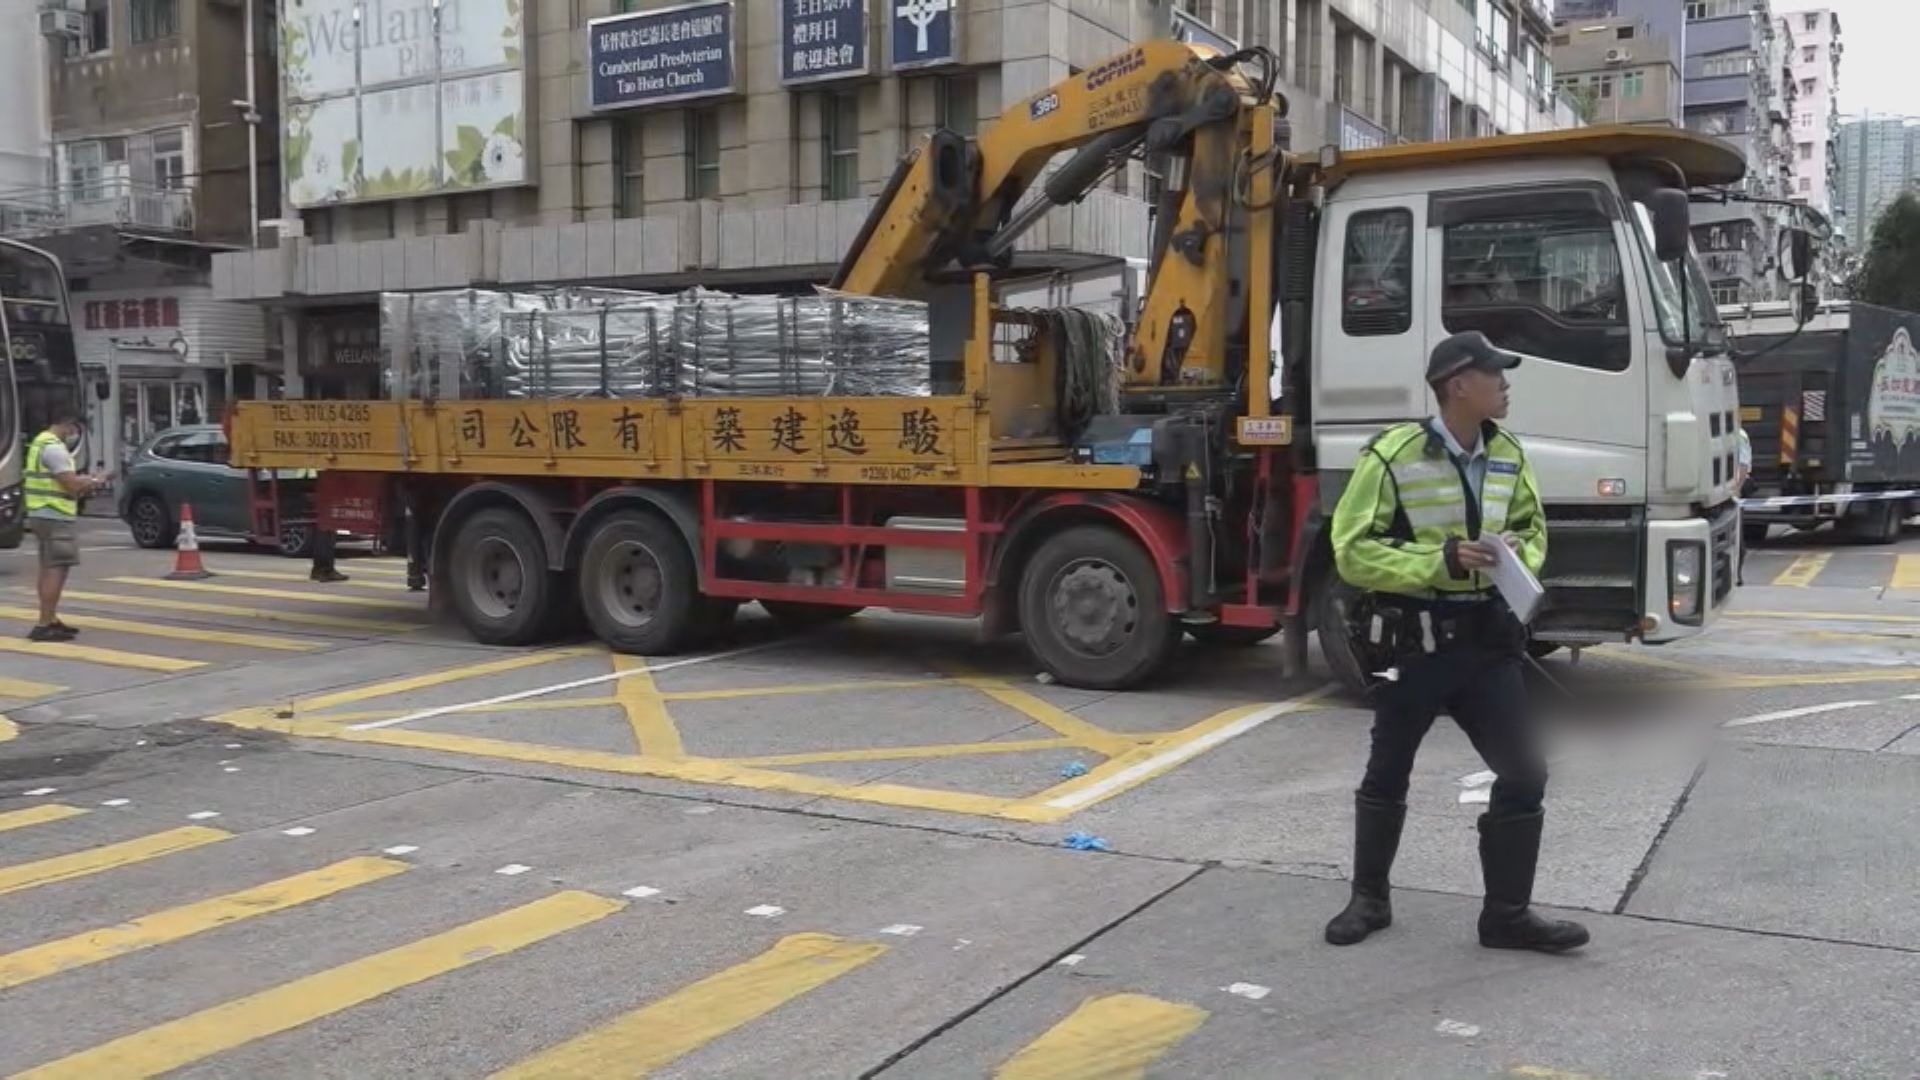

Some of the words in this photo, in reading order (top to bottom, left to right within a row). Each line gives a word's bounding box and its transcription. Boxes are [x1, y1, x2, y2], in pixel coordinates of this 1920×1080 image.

[303, 0, 461, 57] Welland
[600, 54, 659, 77] Cumberland
[660, 46, 723, 68] Presbyterian
[617, 78, 636, 94] Tao
[666, 68, 704, 87] Church
